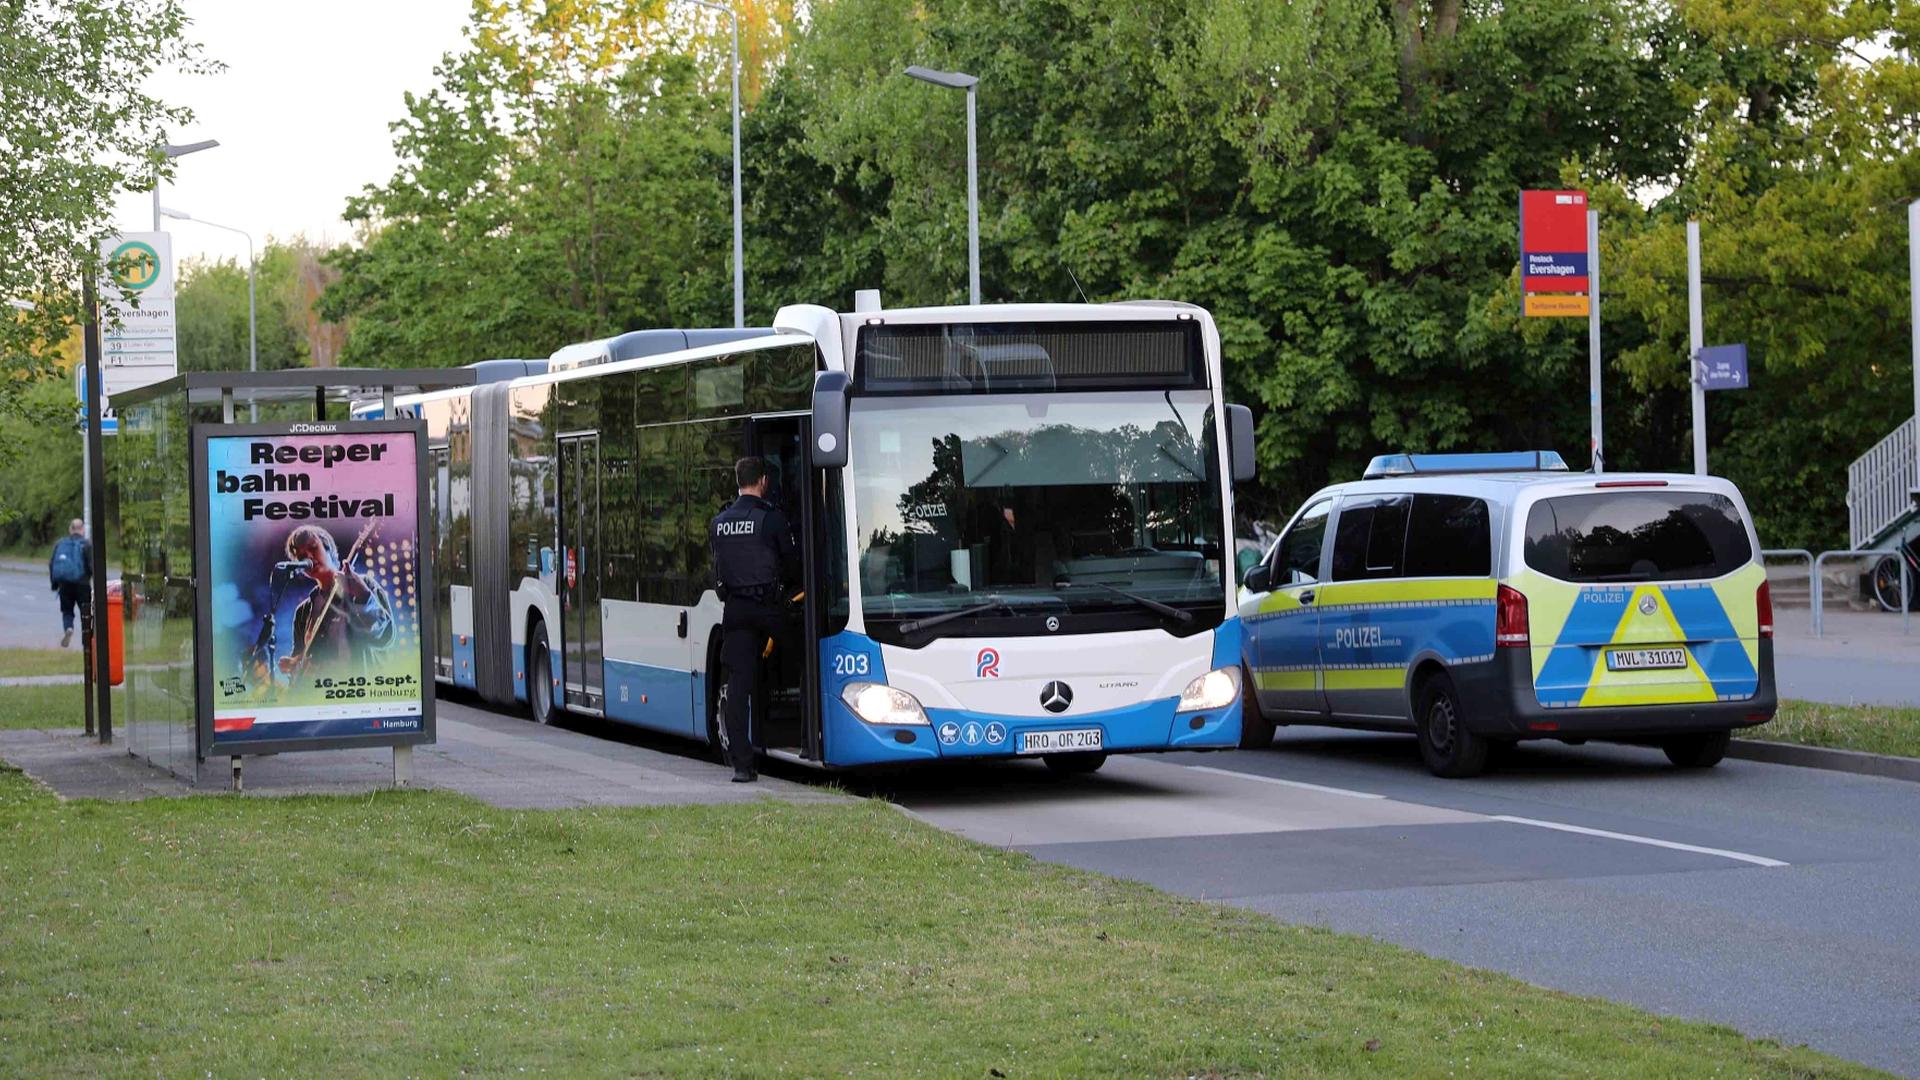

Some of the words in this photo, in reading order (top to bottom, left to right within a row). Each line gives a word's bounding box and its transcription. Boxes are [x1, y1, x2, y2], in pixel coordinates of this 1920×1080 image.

[1530, 255, 1553, 263] Rostock
[1530, 264, 1575, 276] Evershagen
[110, 342, 122, 350] 39
[111, 356, 122, 364] F1
[289, 424, 337, 433] JCDecaux
[250, 442, 387, 468] Reeper
[217, 469, 310, 493] bahn
[243, 494, 394, 521] Festival
[716, 520, 755, 536] POLIZEI
[1583, 592, 1625, 604] POLIZEI
[1336, 626, 1381, 649] POLIZEI
[835, 653, 868, 675] 203
[1616, 652, 1640, 666] MVL
[1647, 650, 1684, 665] 31012
[374, 674, 417, 687] Sept.
[325, 688, 367, 699] 2026
[370, 687, 417, 698] Hamburg
[383, 719, 418, 729] Hamburg
[1025, 734, 1049, 749] HRO
[1059, 733, 1074, 748] OR
[1077, 731, 1100, 746] 203
